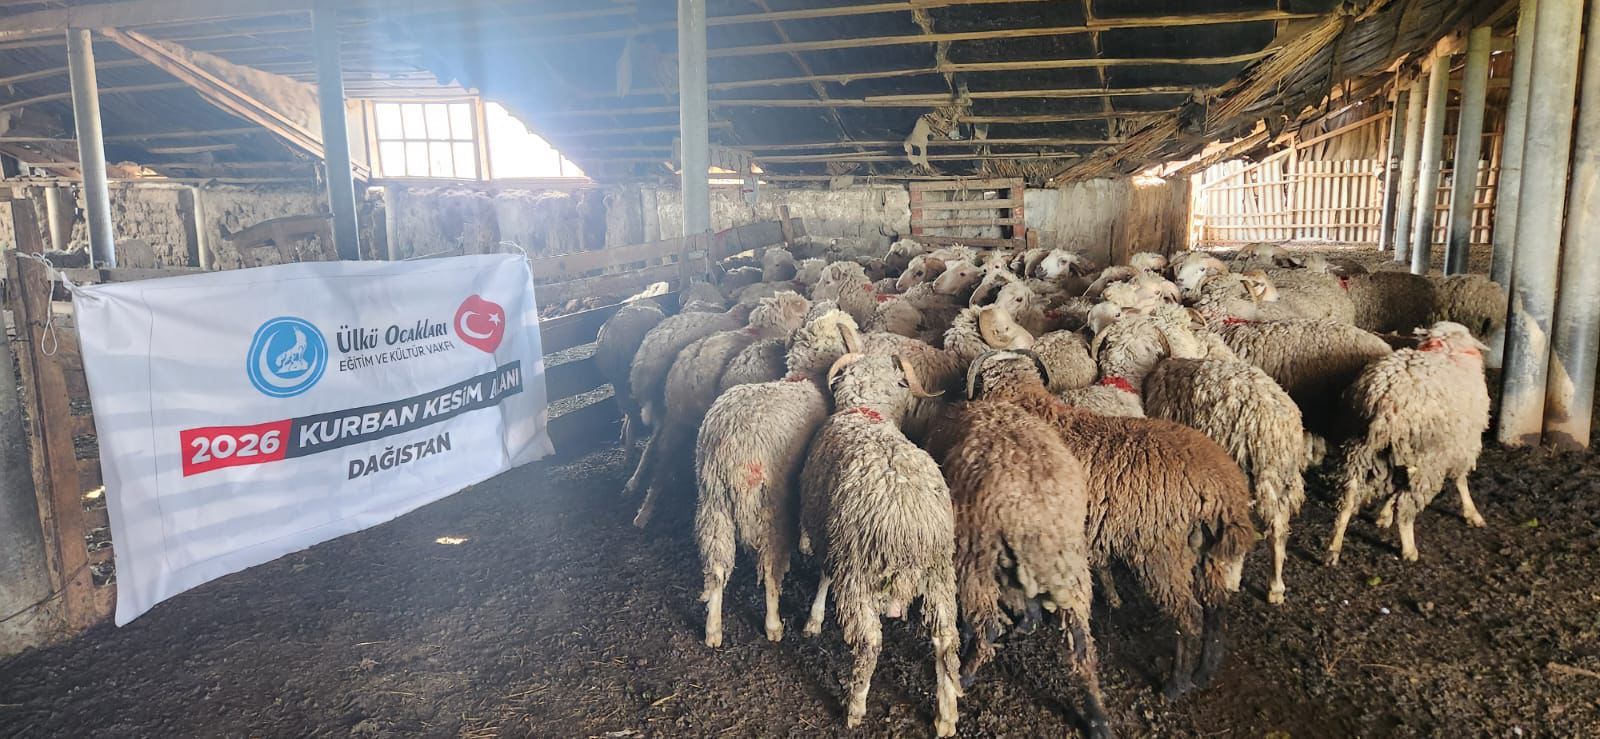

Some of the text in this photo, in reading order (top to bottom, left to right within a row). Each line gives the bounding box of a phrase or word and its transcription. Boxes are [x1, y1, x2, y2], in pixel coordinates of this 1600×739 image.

[336, 325, 379, 353] Ülkü
[339, 354, 374, 372] EĞİTİM
[375, 352, 389, 365] VE
[389, 345, 426, 363] KÜLTÜR
[191, 430, 281, 465] 2026
[299, 403, 419, 448] KURBAN
